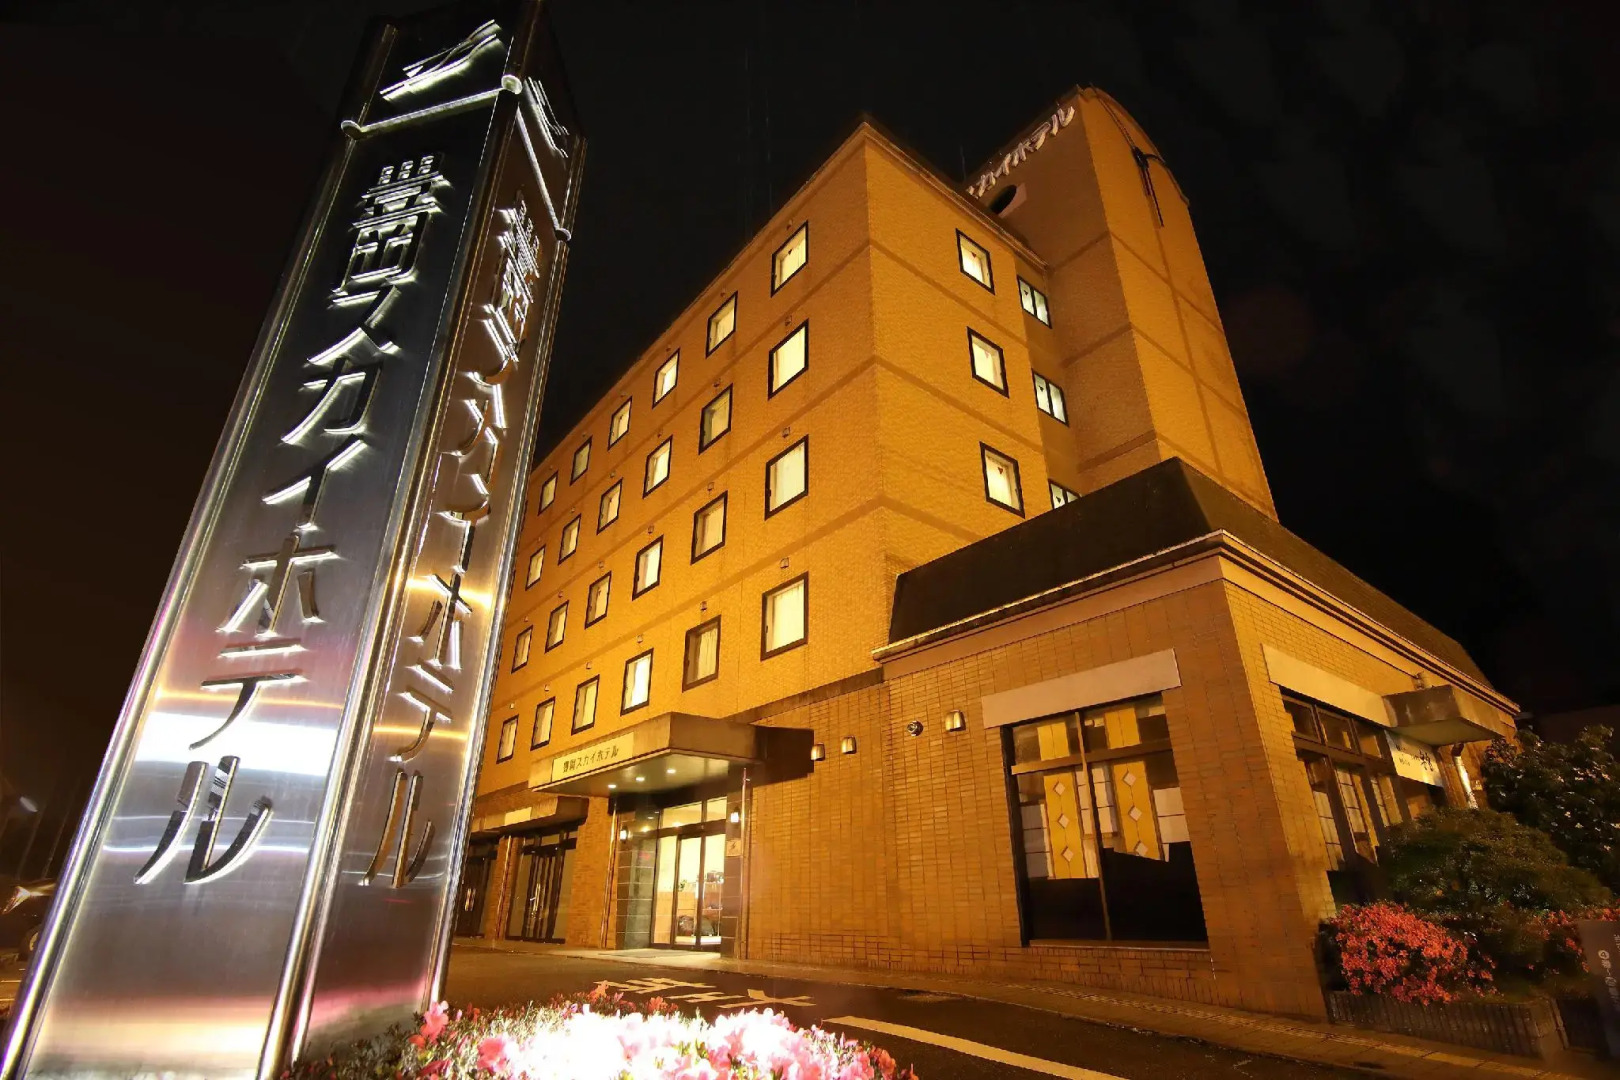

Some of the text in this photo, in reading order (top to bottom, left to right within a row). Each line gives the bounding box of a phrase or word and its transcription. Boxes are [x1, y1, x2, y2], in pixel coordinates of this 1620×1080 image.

[135, 152, 447, 885] 豊岡スカイホテル
[359, 190, 541, 888] 豊岡スカイホテル
